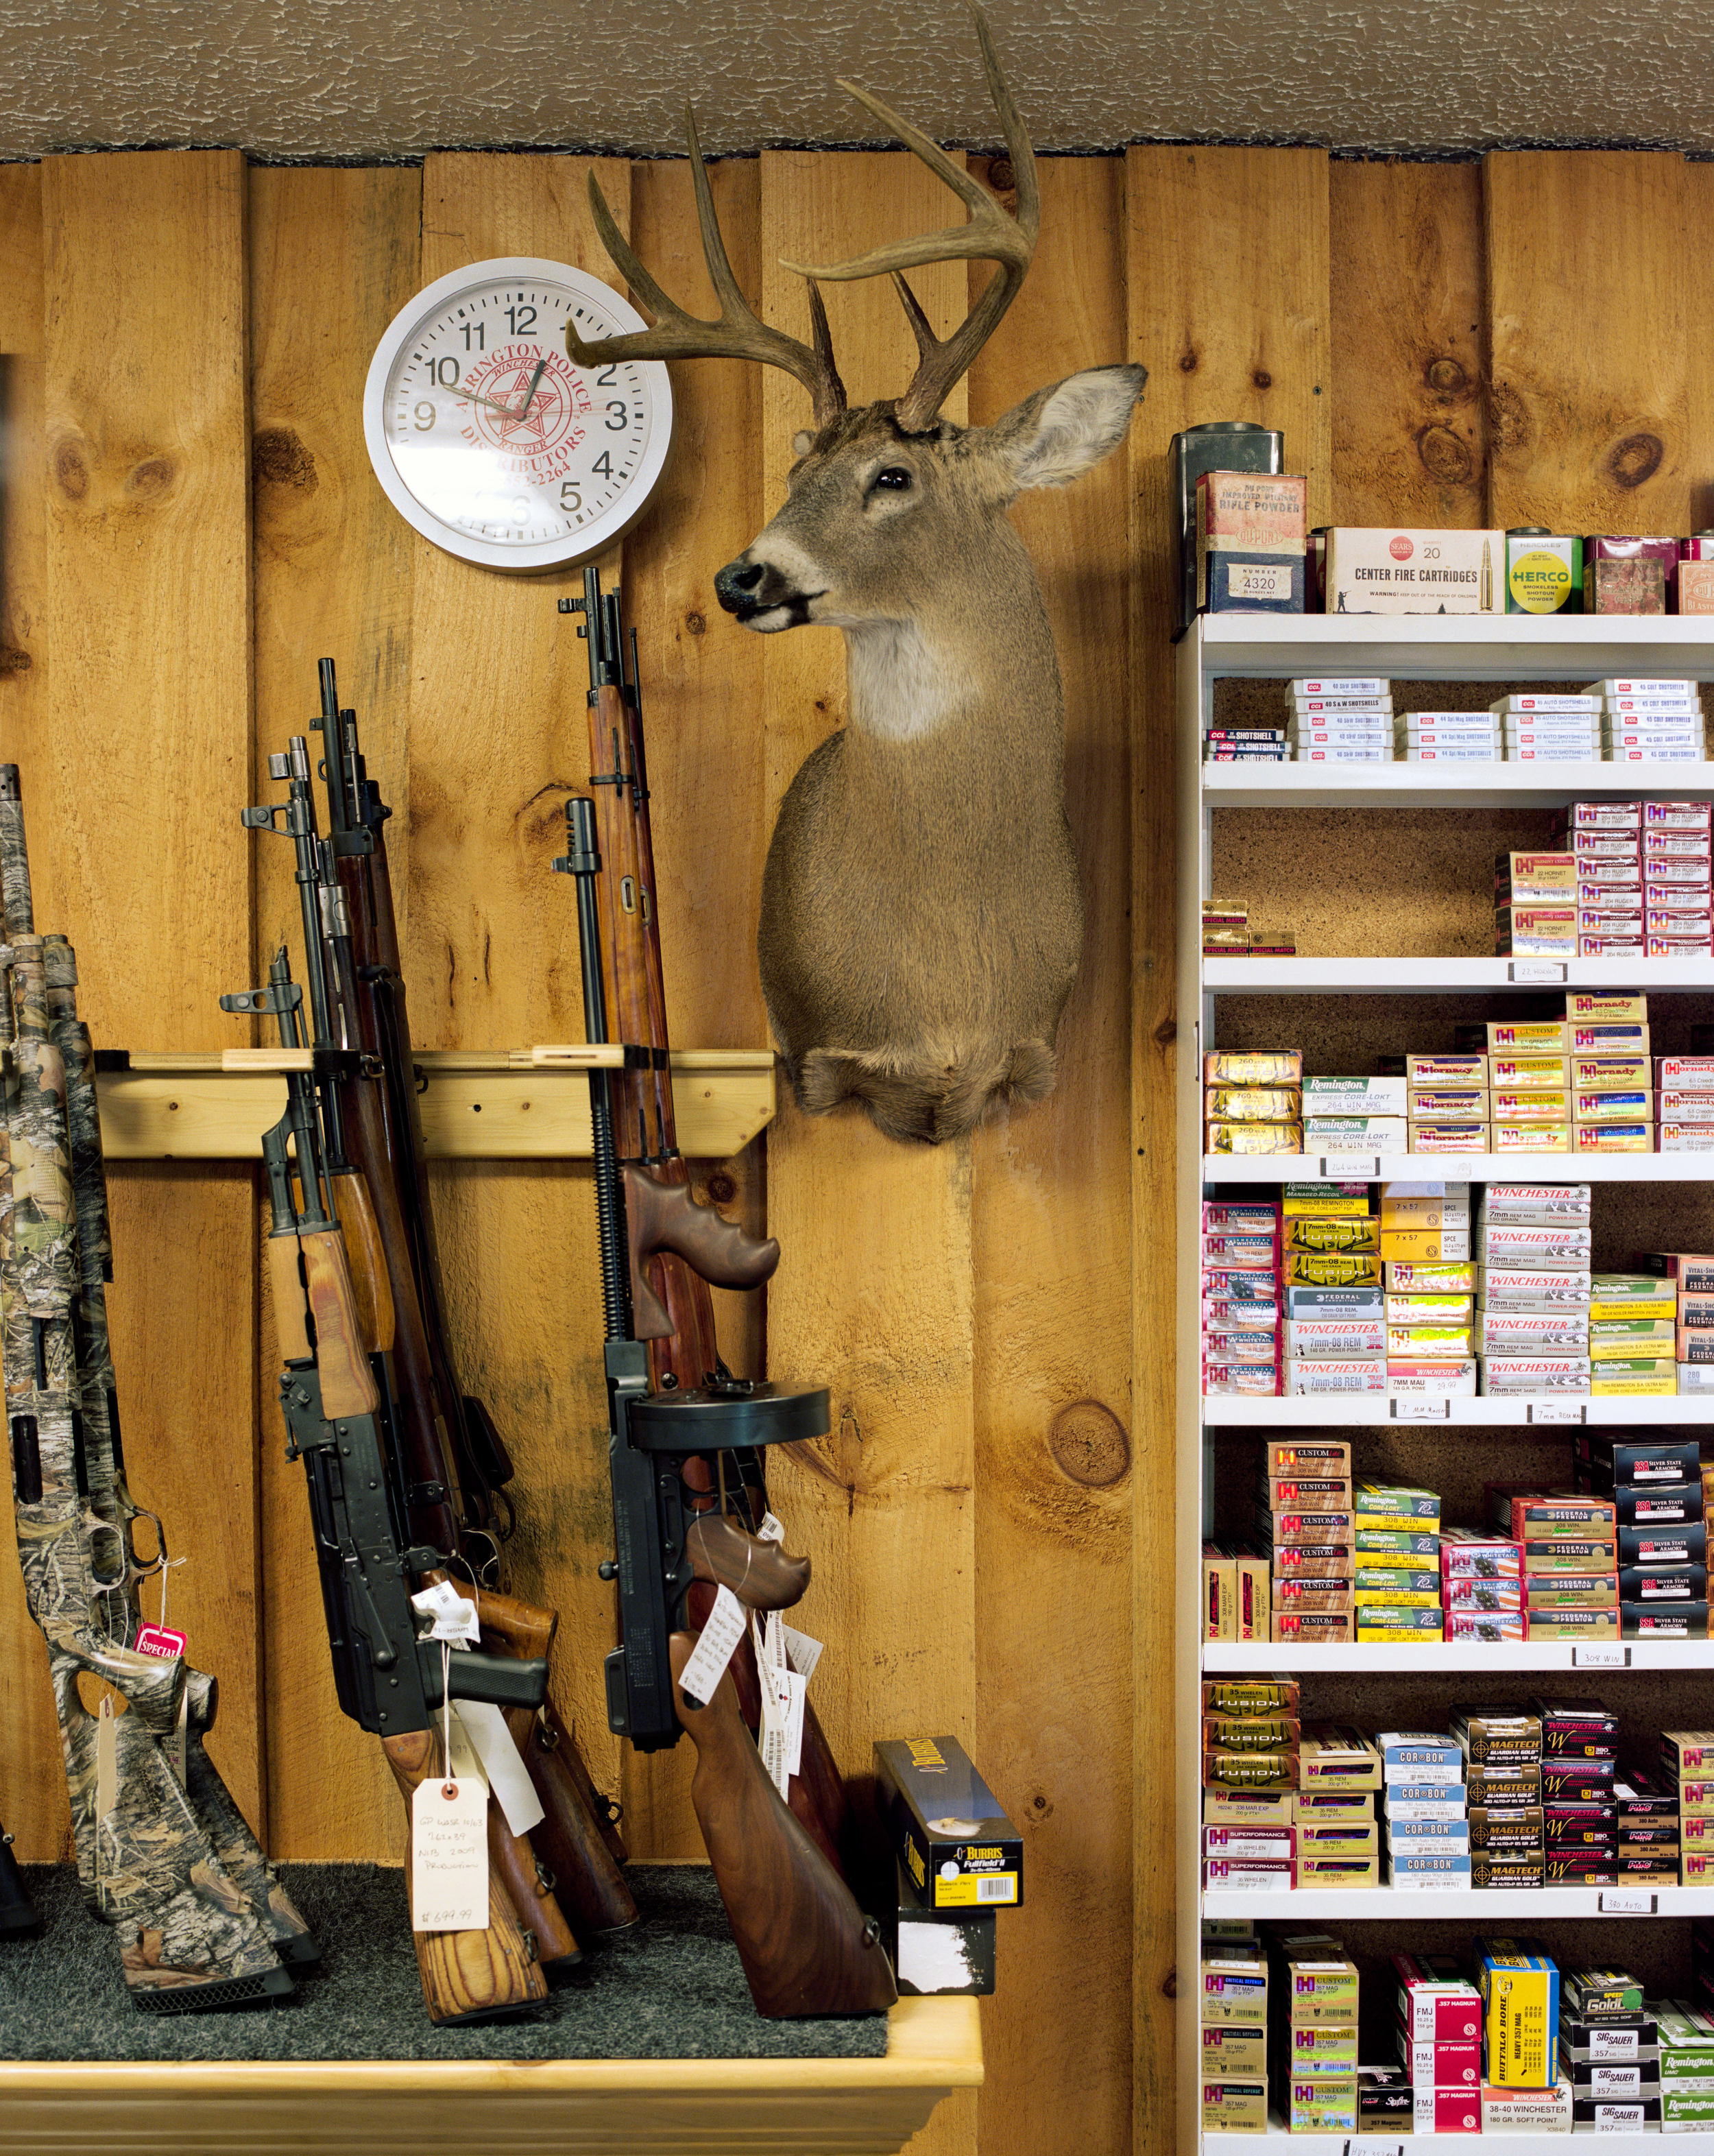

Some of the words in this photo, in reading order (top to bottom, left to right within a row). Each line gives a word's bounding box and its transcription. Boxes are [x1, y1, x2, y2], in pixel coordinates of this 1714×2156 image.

[504, 306, 538, 335] 12
[459, 322, 484, 350] 11
[425, 357, 459, 385] 10
[492, 360, 555, 377] WINCHESER
[456, 343, 543, 413] ARRINGTON
[548, 350, 592, 413] POLICE
[414, 401, 435, 431] 9
[605, 400, 627, 431] 3
[461, 426, 586, 472] DISRIBUTORS
[498, 441, 548, 455] RANGER
[592, 451, 614, 479] 4
[559, 481, 581, 512] 5
[1220, 499, 1250, 510] RIFLE
[1255, 502, 1299, 512] POWDER
[1424, 548, 1440, 559] 20
[1355, 568, 1390, 580] CENTER
[1395, 569, 1415, 581] FIRE
[1420, 570, 1477, 582] CARTRIDGES
[1513, 572, 1569, 582] HERCO
[1244, 578, 1275, 589] 4320
[1236, 732, 1272, 740] SHOTSHELL
[1246, 743, 1281, 751] SHOTSHELL
[1490, 1188, 1570, 1199] WINCHESTER
[1490, 1232, 1570, 1243] WINCHESTER
[1296, 1324, 1379, 1334] WINCHESTER
[1310, 1338, 1343, 1348] 7mm-08
[1345, 1338, 1361, 1347] REM
[1297, 1363, 1380, 1373] WINCHESTER
[1311, 1378, 1344, 1387] 7mm-08
[1346, 1377, 1362, 1387] REM
[1634, 1461, 1650, 1472] SSA
[1419, 1500, 1432, 1511] 75
[141, 1641, 176, 1657] SPECIAL
[1547, 1722, 1603, 1731] WINCHESTER
[1490, 1740, 1539, 1749] MAGTECH
[906, 1738, 945, 1766] BURRIS
[1486, 1784, 1538, 1793] MAGTECH
[1628, 1804, 1651, 1812] PMC
[967, 1847, 1002, 1860] BURRIS
[908, 1835, 925, 1888] BURRIS
[1416, 2007, 1433, 2015] FMJ
[1597, 2033, 1608, 2041] SIG
[1608, 2036, 1632, 2044] SAUER
